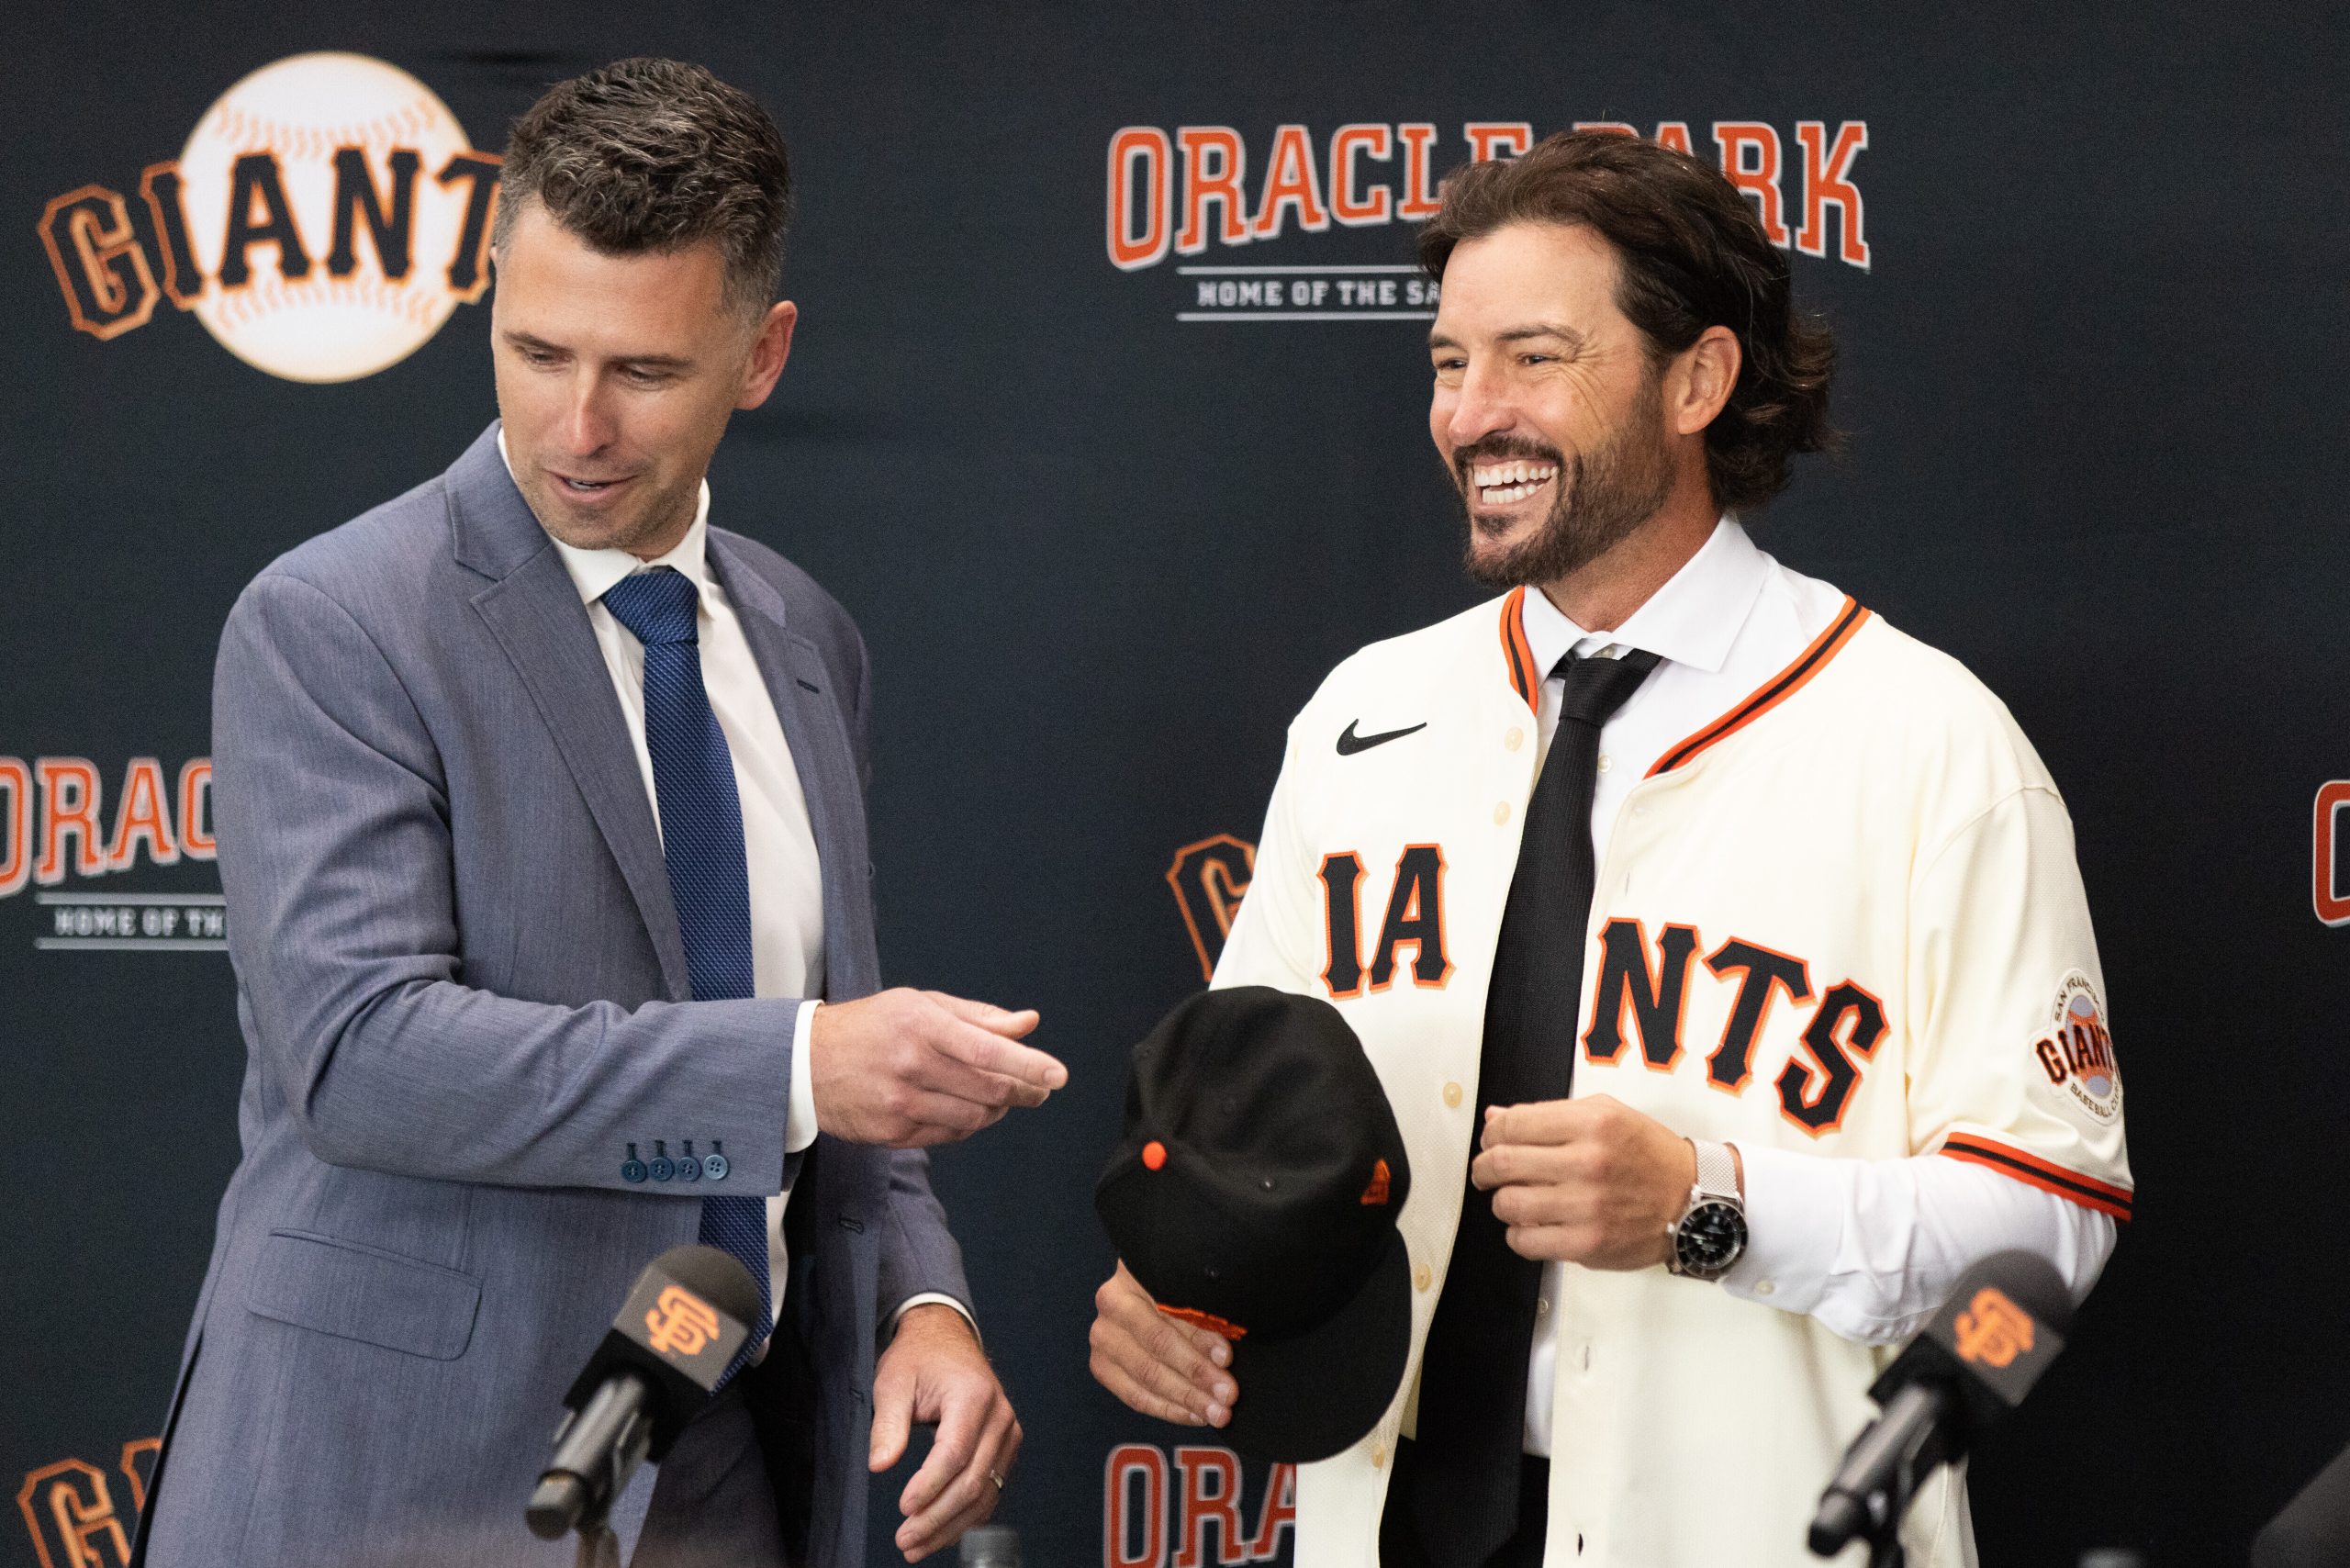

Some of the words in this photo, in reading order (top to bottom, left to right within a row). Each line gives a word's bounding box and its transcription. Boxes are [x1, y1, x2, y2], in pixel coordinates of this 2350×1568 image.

[1197, 281, 1283, 307] HOME
[1291, 281, 1329, 307] OF
[1336, 280, 1397, 306] THE
